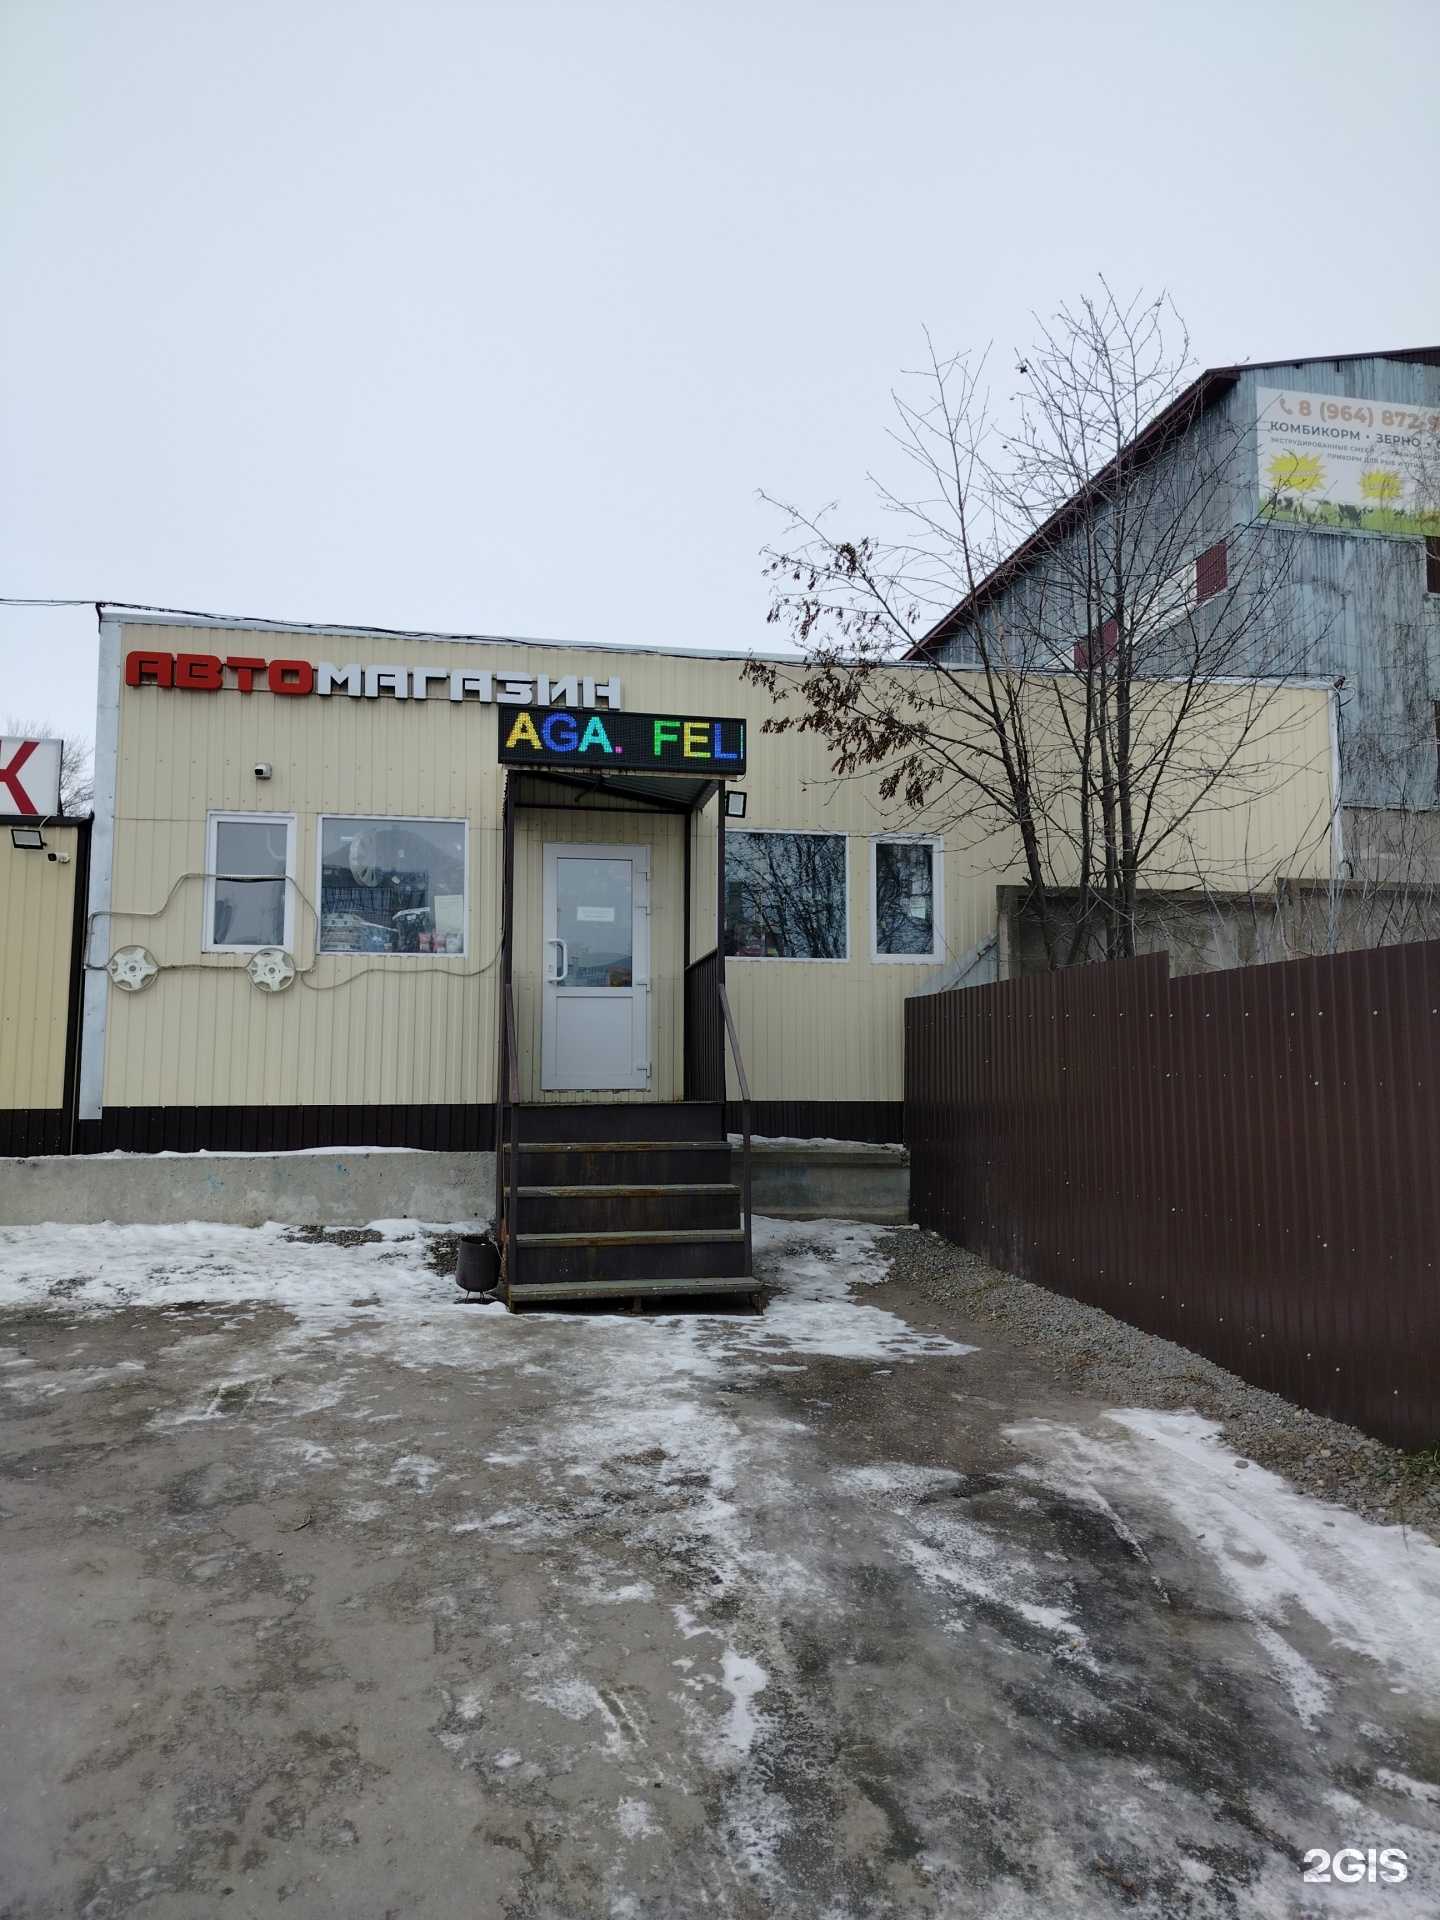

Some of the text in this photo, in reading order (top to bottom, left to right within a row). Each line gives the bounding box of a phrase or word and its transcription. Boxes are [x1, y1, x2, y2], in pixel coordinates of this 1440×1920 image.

[1299, 400, 1312, 416] 8
[1320, 402, 1374, 427] (964)
[1270, 421, 1360, 440] КОМБИКОРМ
[1376, 433, 1421, 447] ЗЕРНО
[506, 712, 623, 753] AGA.
